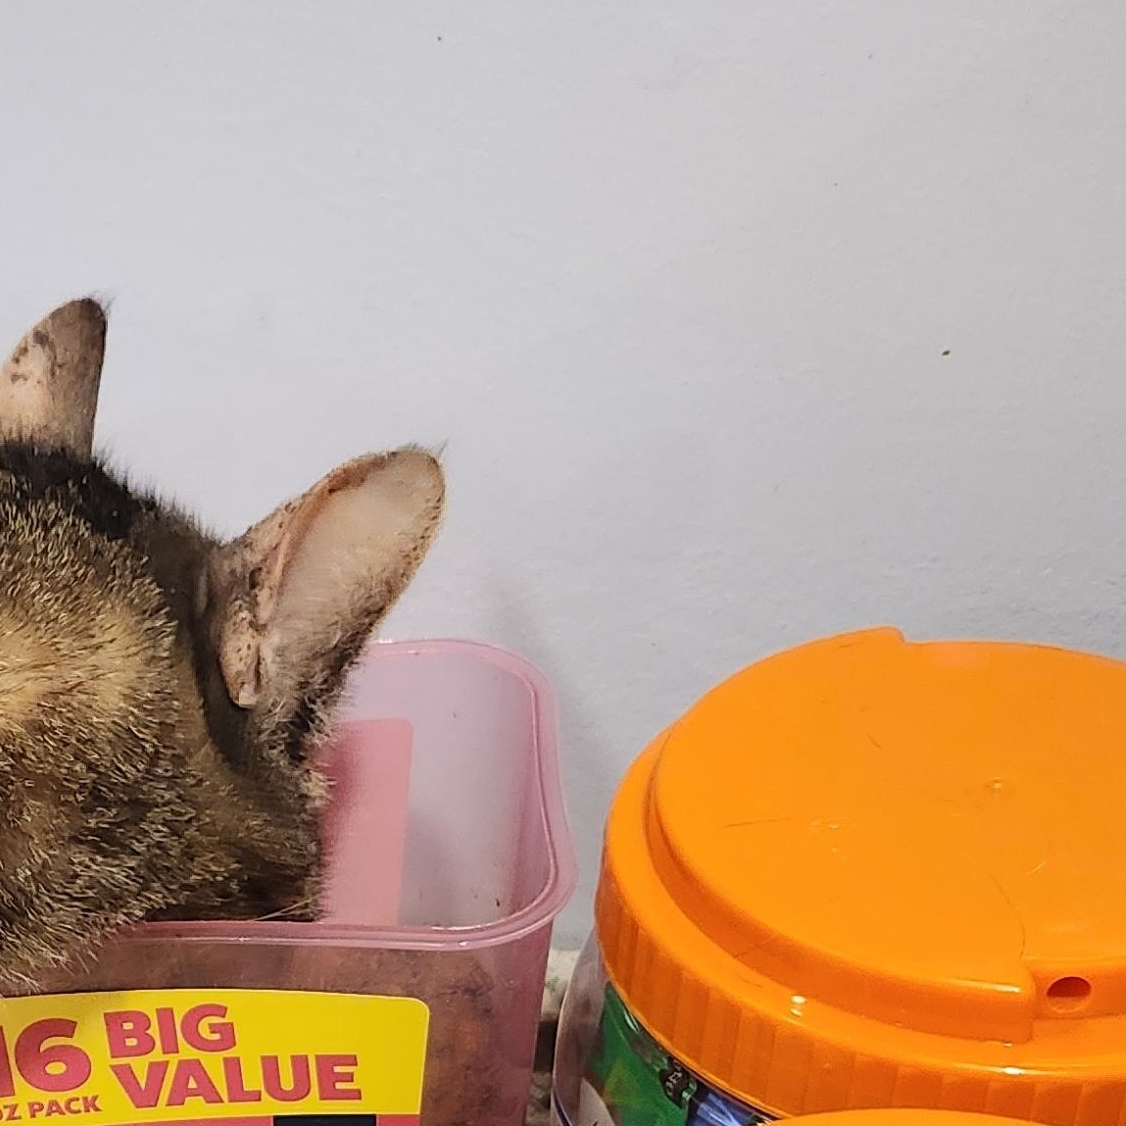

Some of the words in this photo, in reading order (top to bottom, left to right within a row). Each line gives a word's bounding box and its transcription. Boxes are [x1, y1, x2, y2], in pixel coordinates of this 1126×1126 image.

[104, 1003, 237, 1058] BIG
[27, 1095, 103, 1119] PACK
[109, 1054, 363, 1109] VALUE
